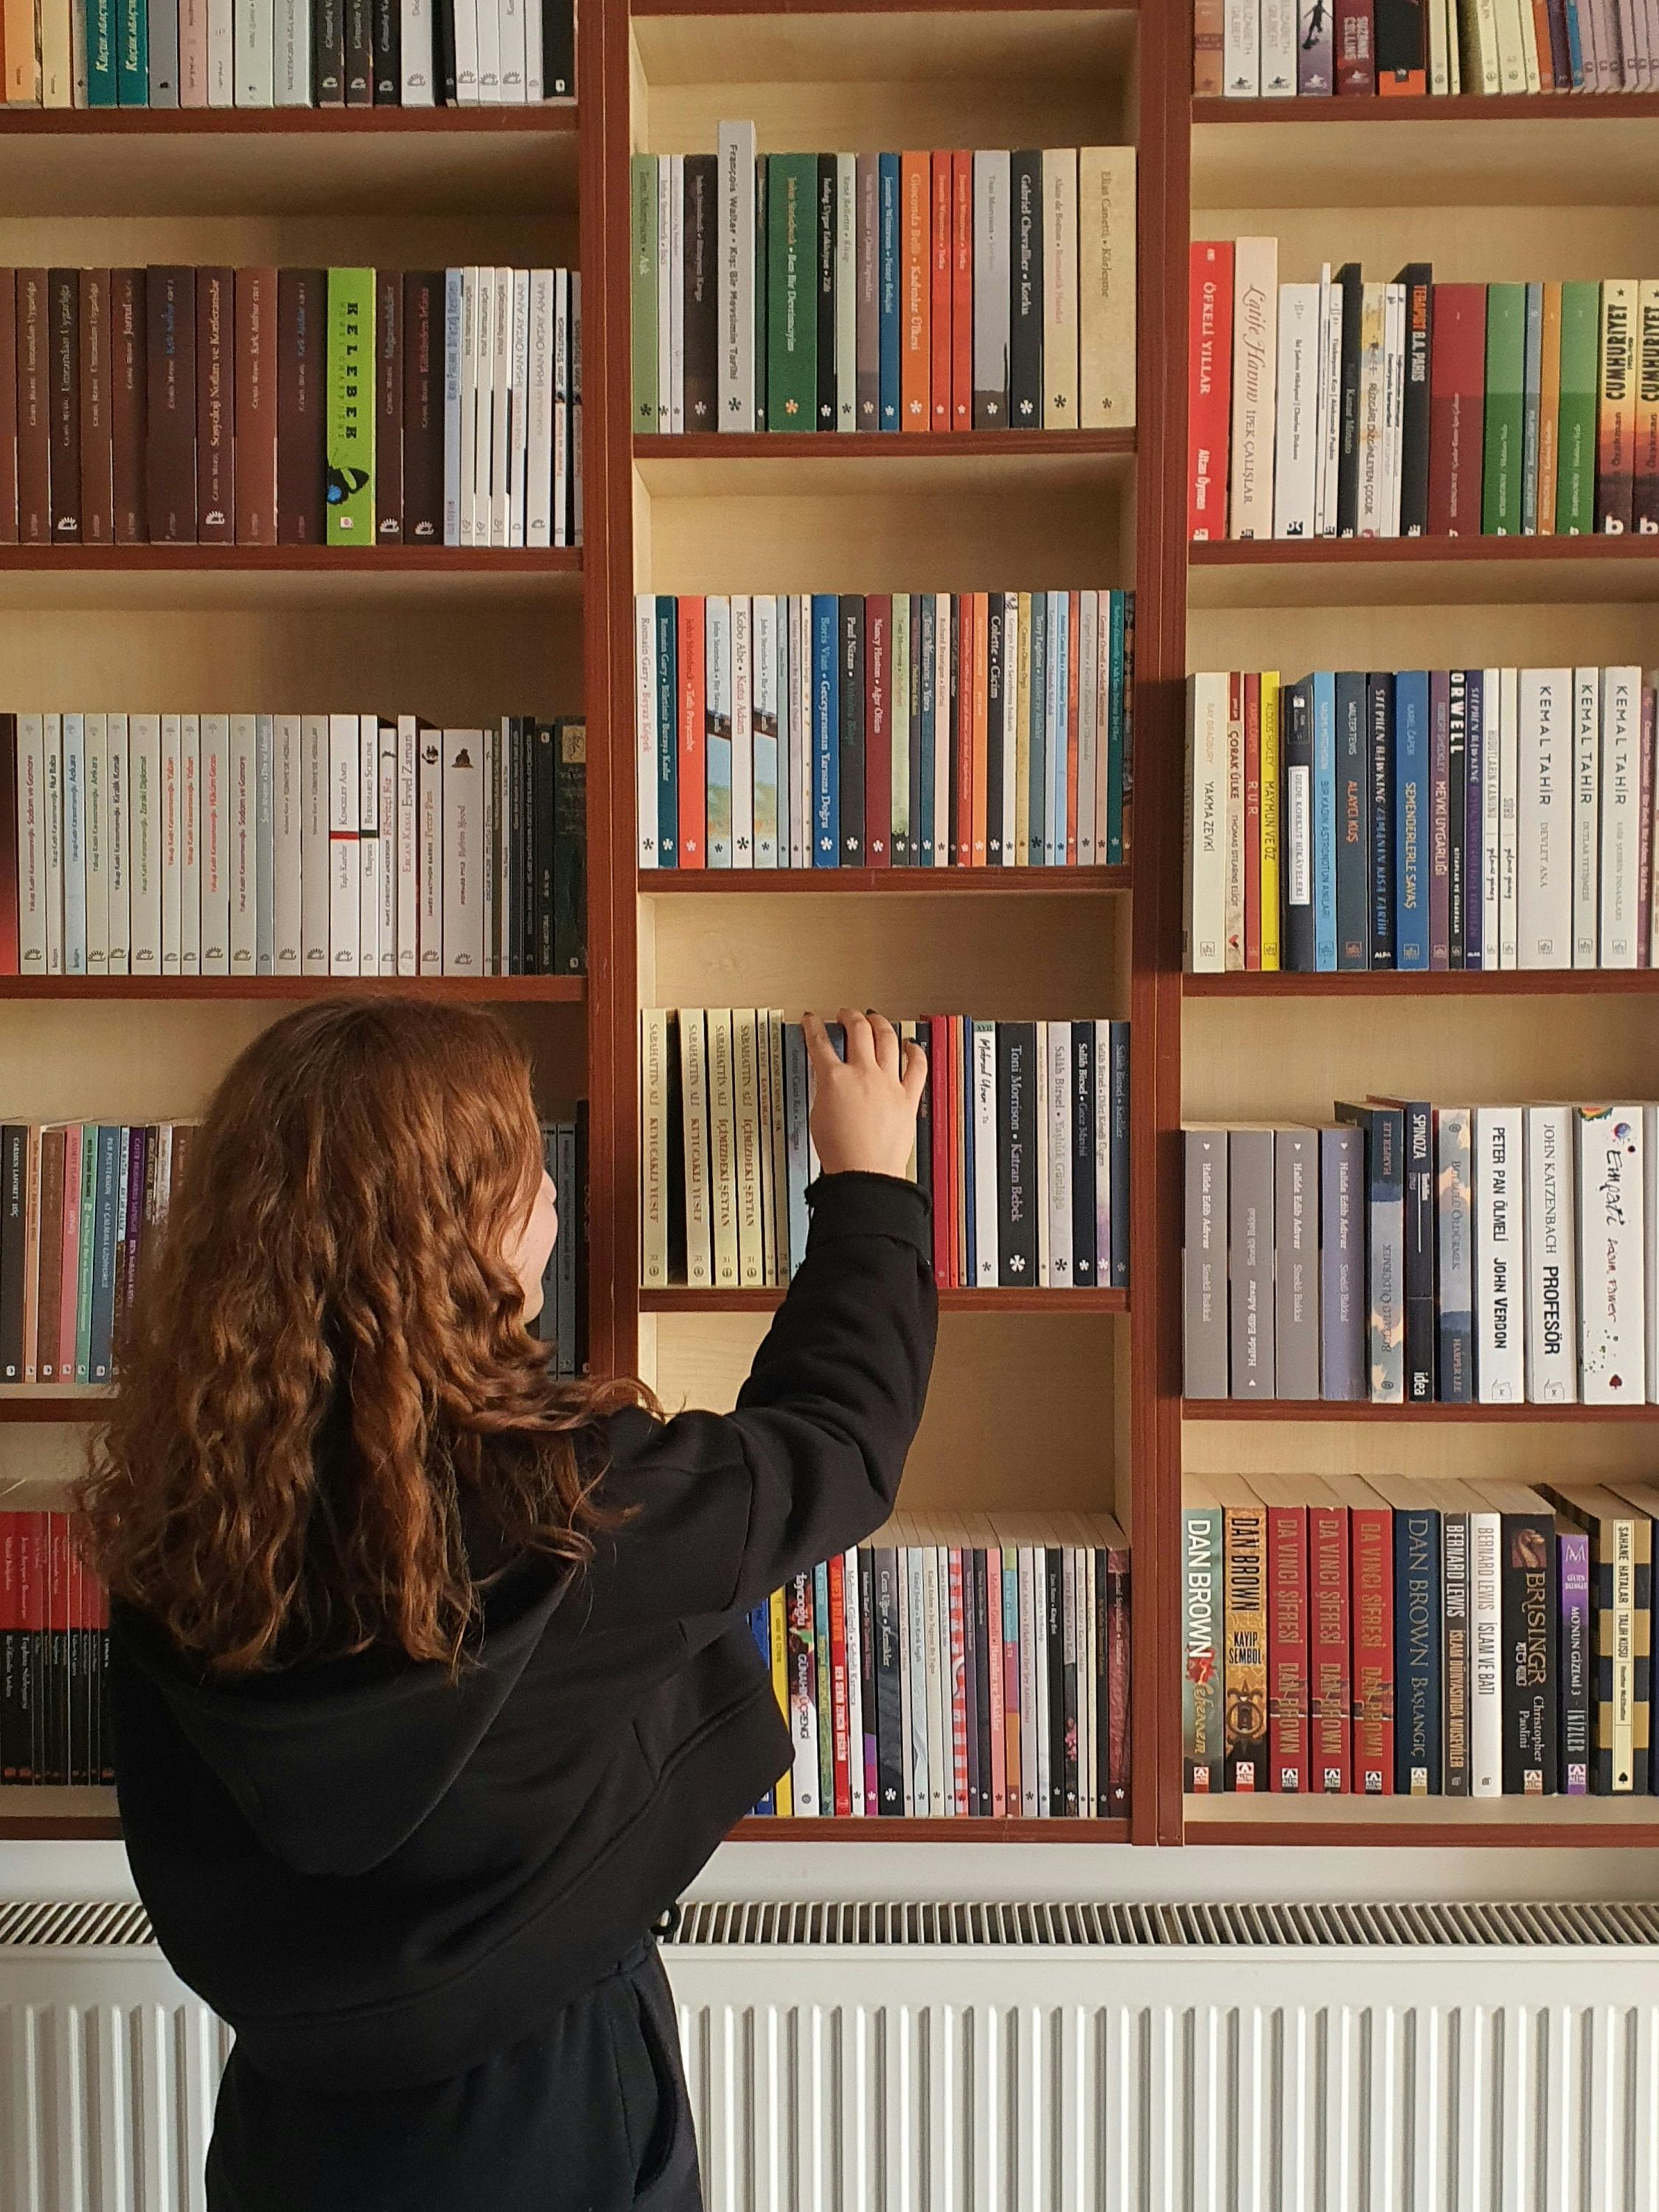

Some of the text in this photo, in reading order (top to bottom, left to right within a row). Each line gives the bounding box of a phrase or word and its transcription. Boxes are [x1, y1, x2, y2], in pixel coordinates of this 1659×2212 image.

[1344, 17, 1356, 60] COLLINS
[347, 302, 358, 439] KELEBEK
[1411, 352, 1424, 381] PARIS
[1607, 303, 1627, 400] CUMHURİYET
[1195, 282, 1215, 509] ÖFKELİ YILLAR Altan Öymen
[1245, 410, 1256, 437] İPEK
[1242, 441, 1254, 504] ÇALIŞLAR
[641, 618, 650, 654] Romain
[737, 611, 745, 640] Kobo
[991, 616, 999, 653] Colette
[640, 657, 650, 681] Gary
[737, 643, 745, 663] Abe
[1452, 673, 1464, 754] ORWELL
[402, 735, 412, 774] Zaman
[1540, 686, 1551, 804] KEMAL TAHİR
[1581, 685, 1593, 804] KEMAL TAHİR
[1616, 686, 1627, 804] KEMAL TAHİR
[1230, 731, 1240, 799] ÇORAK ÜLKE
[1203, 781, 1214, 818] YAKMA
[1295, 774, 1304, 798] DEDE
[1265, 781, 1276, 860] MAYMUN VE ÖZ
[1295, 800, 1304, 838] KORKUT
[1346, 781, 1357, 842] ALAYCI KUŞ
[1404, 782, 1416, 908] SEMENDERLERLE SAVAŞ
[1055, 1078, 1064, 1107] Birsel
[1011, 1046, 1021, 1222] Toni Morrison Katran Bebek
[1413, 1114, 1427, 1158] SPINOZA
[1493, 1127, 1506, 1163] PETER
[1203, 1163, 1211, 1193] Halide
[1293, 1163, 1302, 1193] Halide
[1340, 1162, 1349, 1193] Halide
[1493, 1170, 1506, 1194] PAN
[650, 1187, 658, 1222] YUSUF
[1203, 1196, 1211, 1215] Edib
[1293, 1196, 1302, 1215] Edib
[1340, 1195, 1349, 1215] Edib
[1543, 1124, 1562, 1354] JOHN KATZENBACH PROFESÖR
[1494, 1258, 1506, 1293] JOHN
[1248, 1314, 1256, 1334] Edib
[1494, 1298, 1507, 1349] VERDON
[1248, 1337, 1256, 1366] Halide
[1414, 1372, 1428, 1394] idea
[1188, 1520, 1210, 1567] DAN
[1278, 1520, 1297, 1537] DA
[1320, 1520, 1338, 1538] DA
[1361, 1523, 1380, 1542] DA
[1409, 1519, 1428, 1570] DAN
[1231, 1517, 1260, 1611] DAN BROWN
[1279, 1544, 1297, 1585] VINCI
[1321, 1543, 1339, 1585] VINCI
[1362, 1548, 1381, 1588] VINCI
[1446, 1525, 1463, 1579] BERNARD
[1447, 1584, 1464, 1617] LEWIS
[1618, 1565, 1630, 1603] HATALAR
[1188, 1572, 1211, 1658] BROWN
[1410, 1580, 1429, 1666] BROWN
[1478, 1528, 1498, 1694] BERNARD LEWIS İSLAM VE BATI
[1523, 1572, 1545, 1686] BRISINGR
[1229, 1649, 1262, 1663] SEMBOL
[1234, 1631, 1258, 1646] KAYIP
[1450, 1630, 1464, 1657] İSLAM
[1279, 1663, 1298, 1691] DAN
[1321, 1663, 1340, 1691] DAN
[1363, 1666, 1382, 1694] DAN
[1279, 1699, 1299, 1753] BROWN
[1321, 1699, 1340, 1753] BROWN
[1363, 1701, 1382, 1757] BROWN
[1518, 1710, 1530, 1748] Paolini
[1531, 1695, 1545, 1762] Christopher
